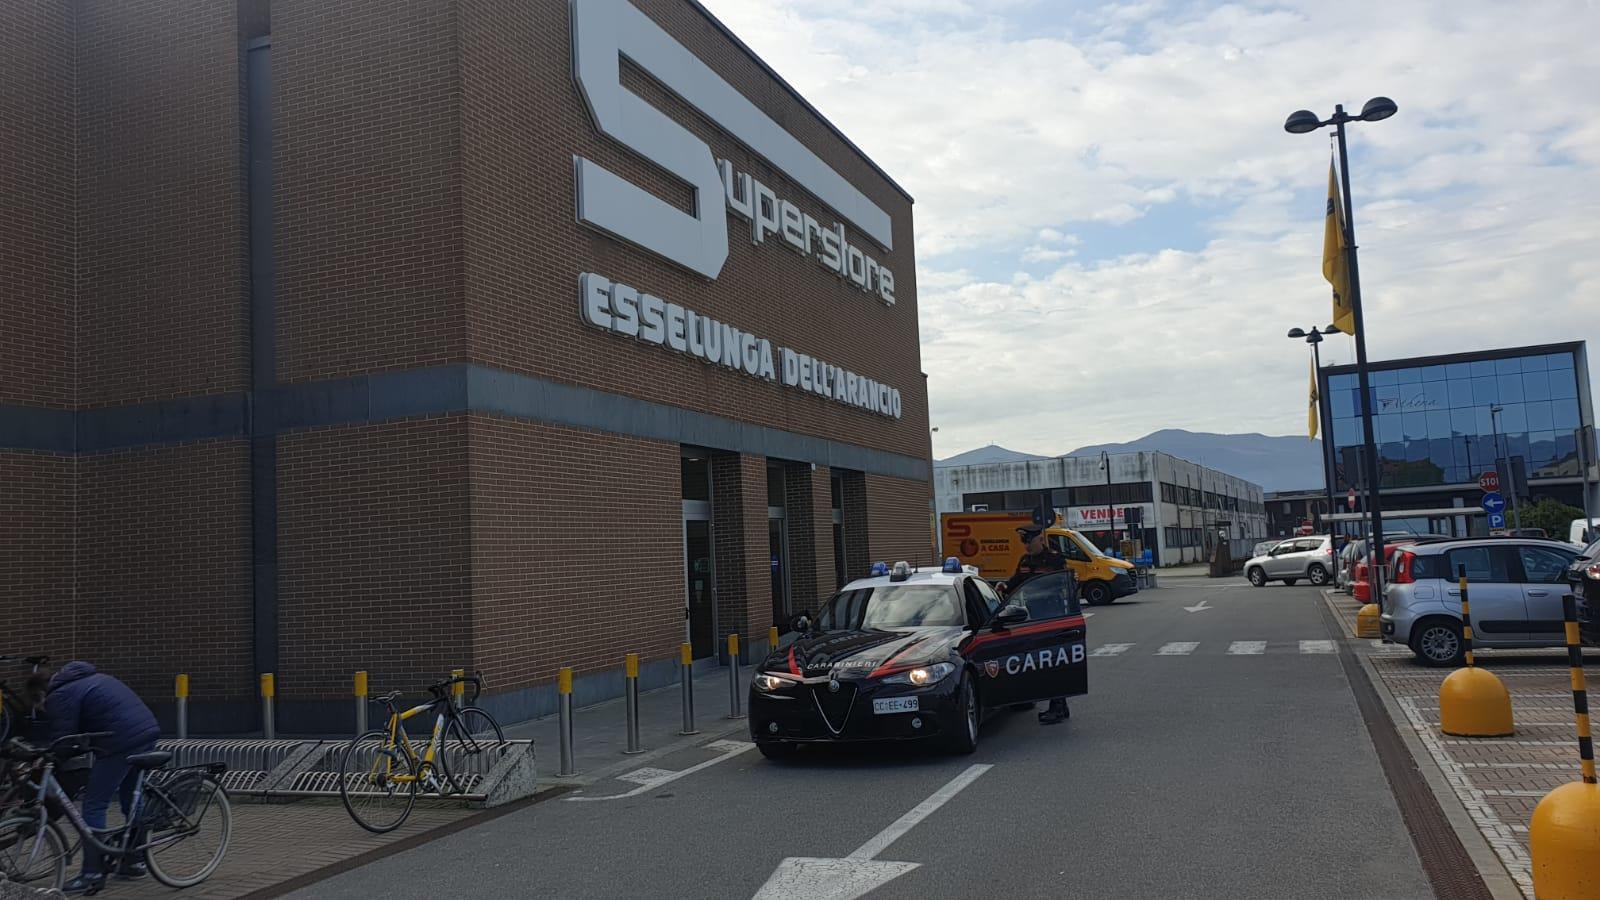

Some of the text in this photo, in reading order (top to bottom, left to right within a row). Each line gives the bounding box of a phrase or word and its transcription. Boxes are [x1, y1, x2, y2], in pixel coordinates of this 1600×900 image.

[570, 0, 895, 305] Superstore
[579, 271, 901, 419] ESSELUNGA DELL'ARANCIO
[1080, 507, 1125, 520] VENDE
[1492, 515, 1502, 527] P
[988, 544, 1010, 552] CASA
[807, 661, 876, 670] CARABINIERI
[1006, 644, 1085, 675] CARAB
